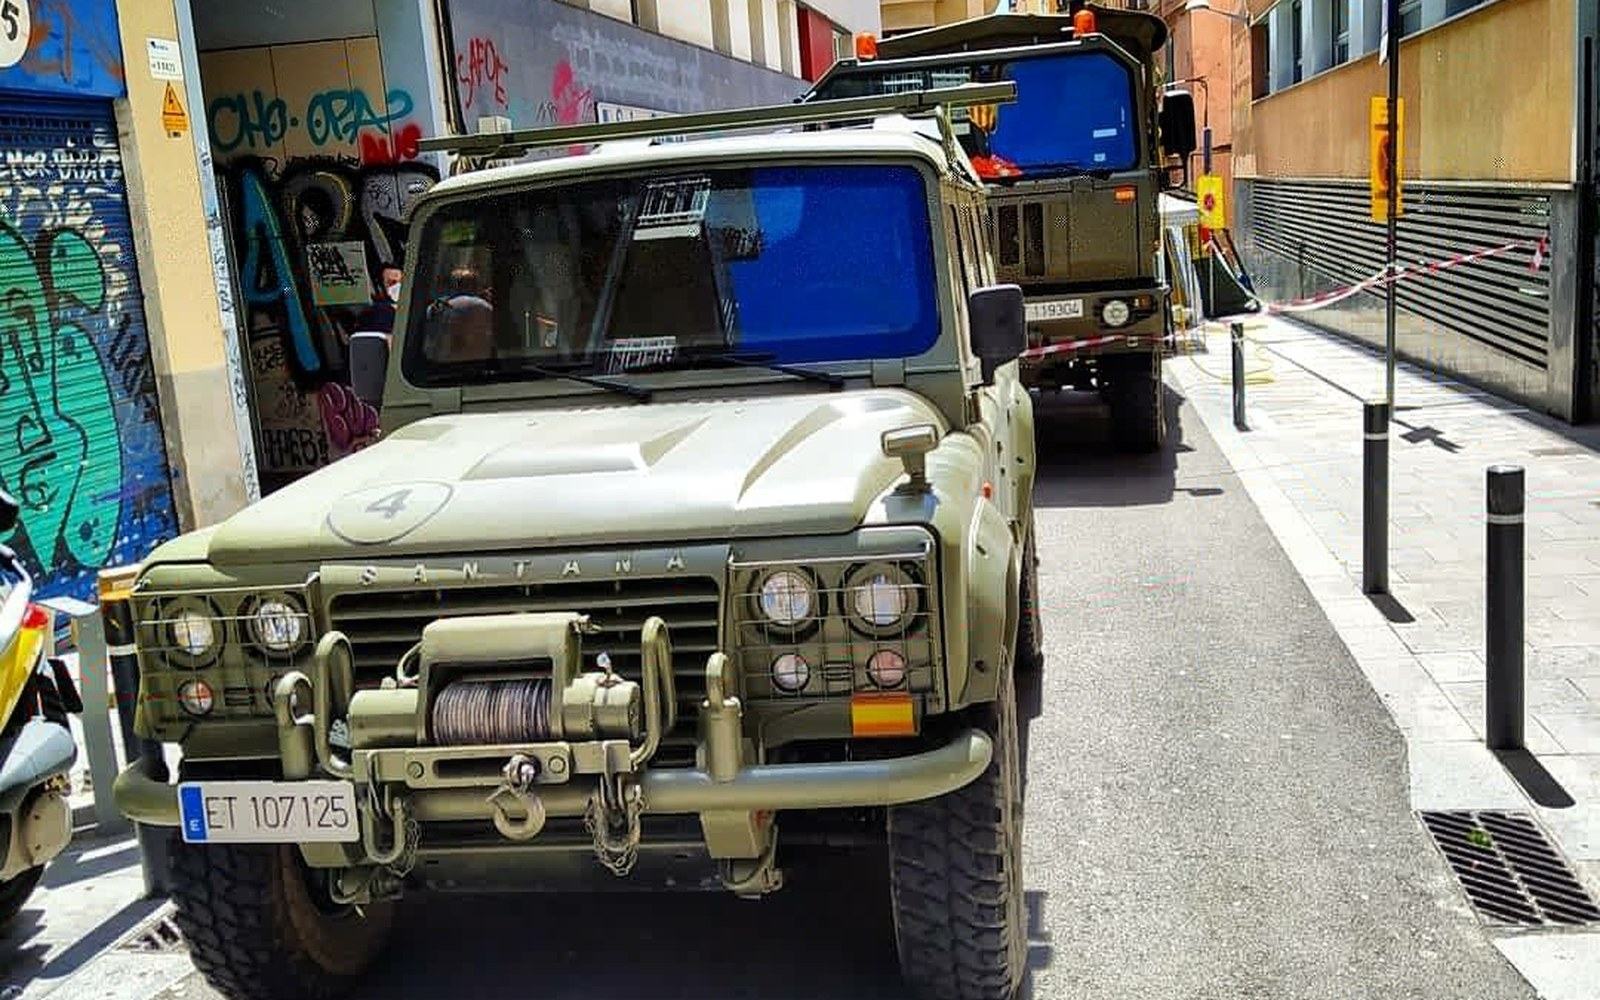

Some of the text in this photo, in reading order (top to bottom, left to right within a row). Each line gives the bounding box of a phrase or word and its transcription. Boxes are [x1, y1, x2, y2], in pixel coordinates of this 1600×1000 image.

[1, 0, 19, 41] 5
[365, 488, 414, 520] 4
[359, 557, 687, 587] SANTANA
[205, 795, 350, 830] ET 107125
